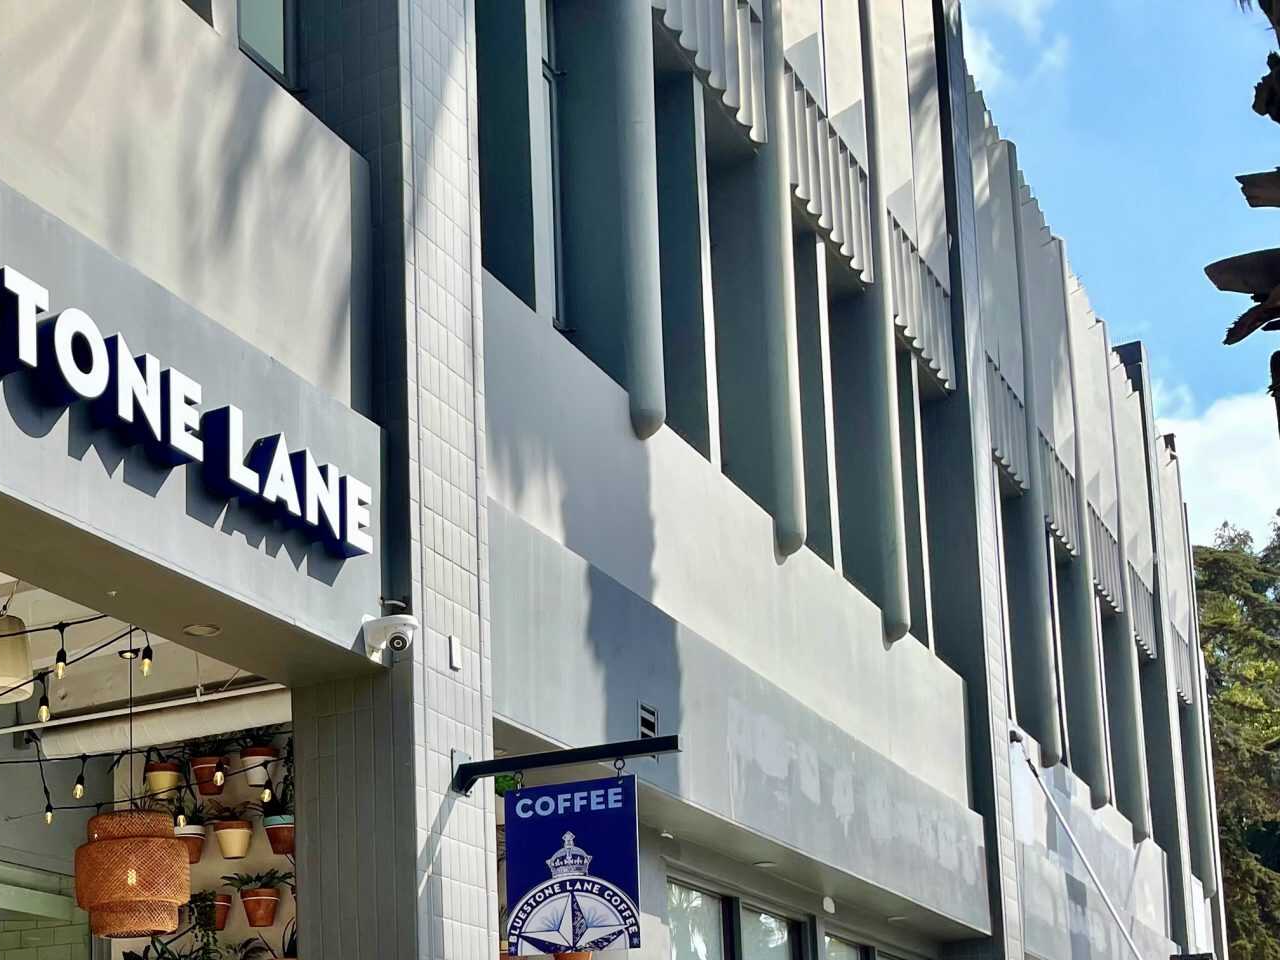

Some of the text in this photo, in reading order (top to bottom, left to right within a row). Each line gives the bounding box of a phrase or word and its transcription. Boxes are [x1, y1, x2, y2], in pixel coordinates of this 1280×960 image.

[226, 404, 373, 558] LANE
[516, 787, 623, 818] COFFEE
[509, 881, 638, 943] BLUESTONE LANE COFFEE
